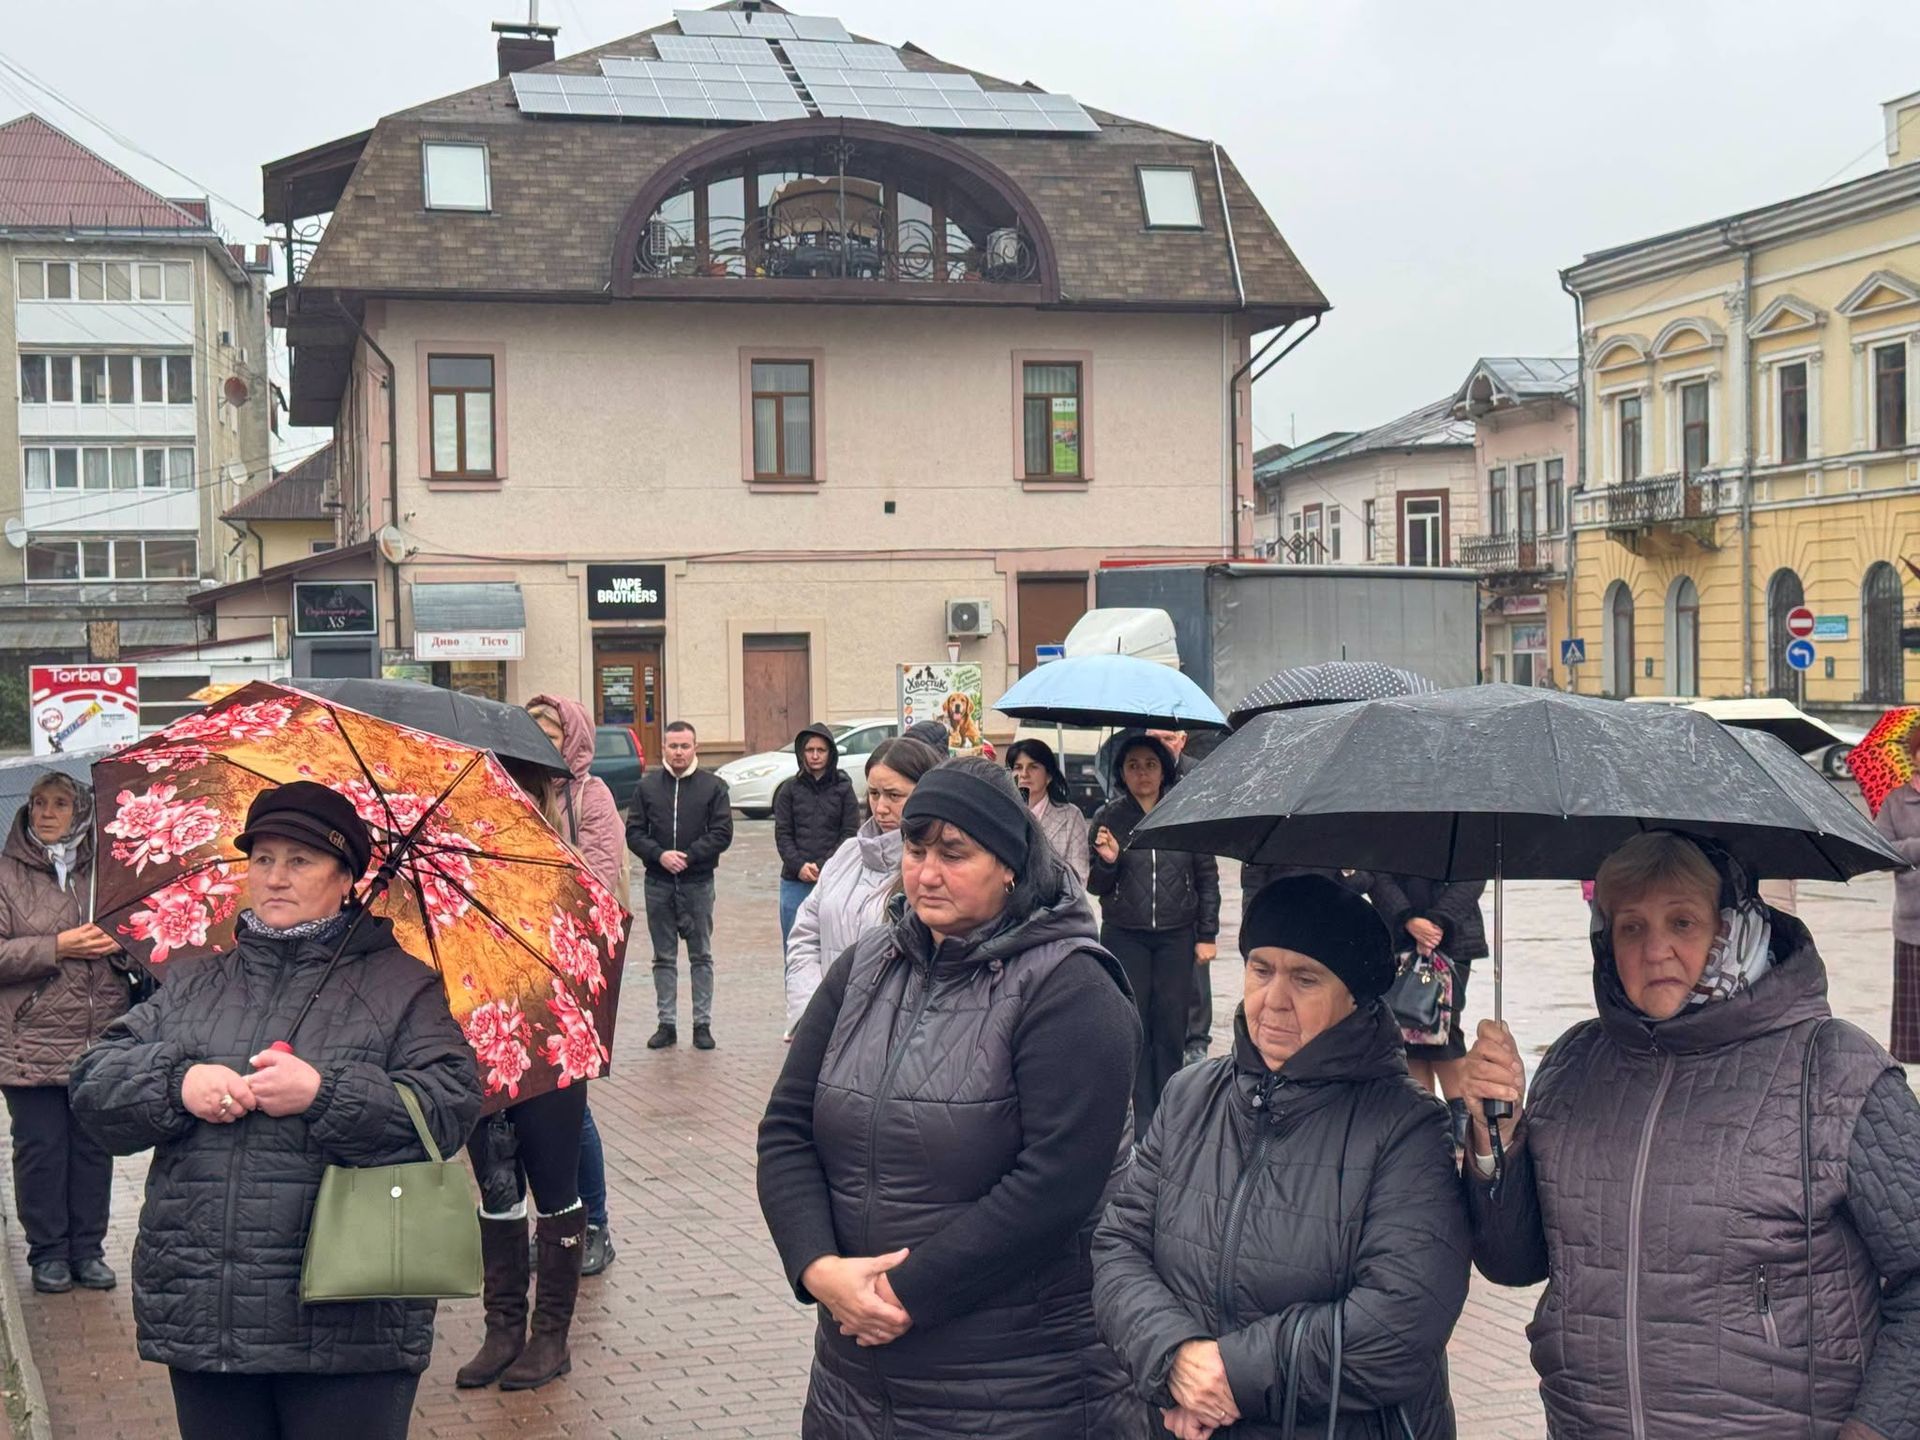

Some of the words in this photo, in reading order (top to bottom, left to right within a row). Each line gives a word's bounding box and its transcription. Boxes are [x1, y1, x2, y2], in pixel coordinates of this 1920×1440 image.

[612, 578, 642, 592] VAPE
[597, 589, 658, 603] BROTHERS
[431, 636, 460, 649] Диво
[480, 636, 509, 647] Тісто
[48, 667, 101, 682] Torba
